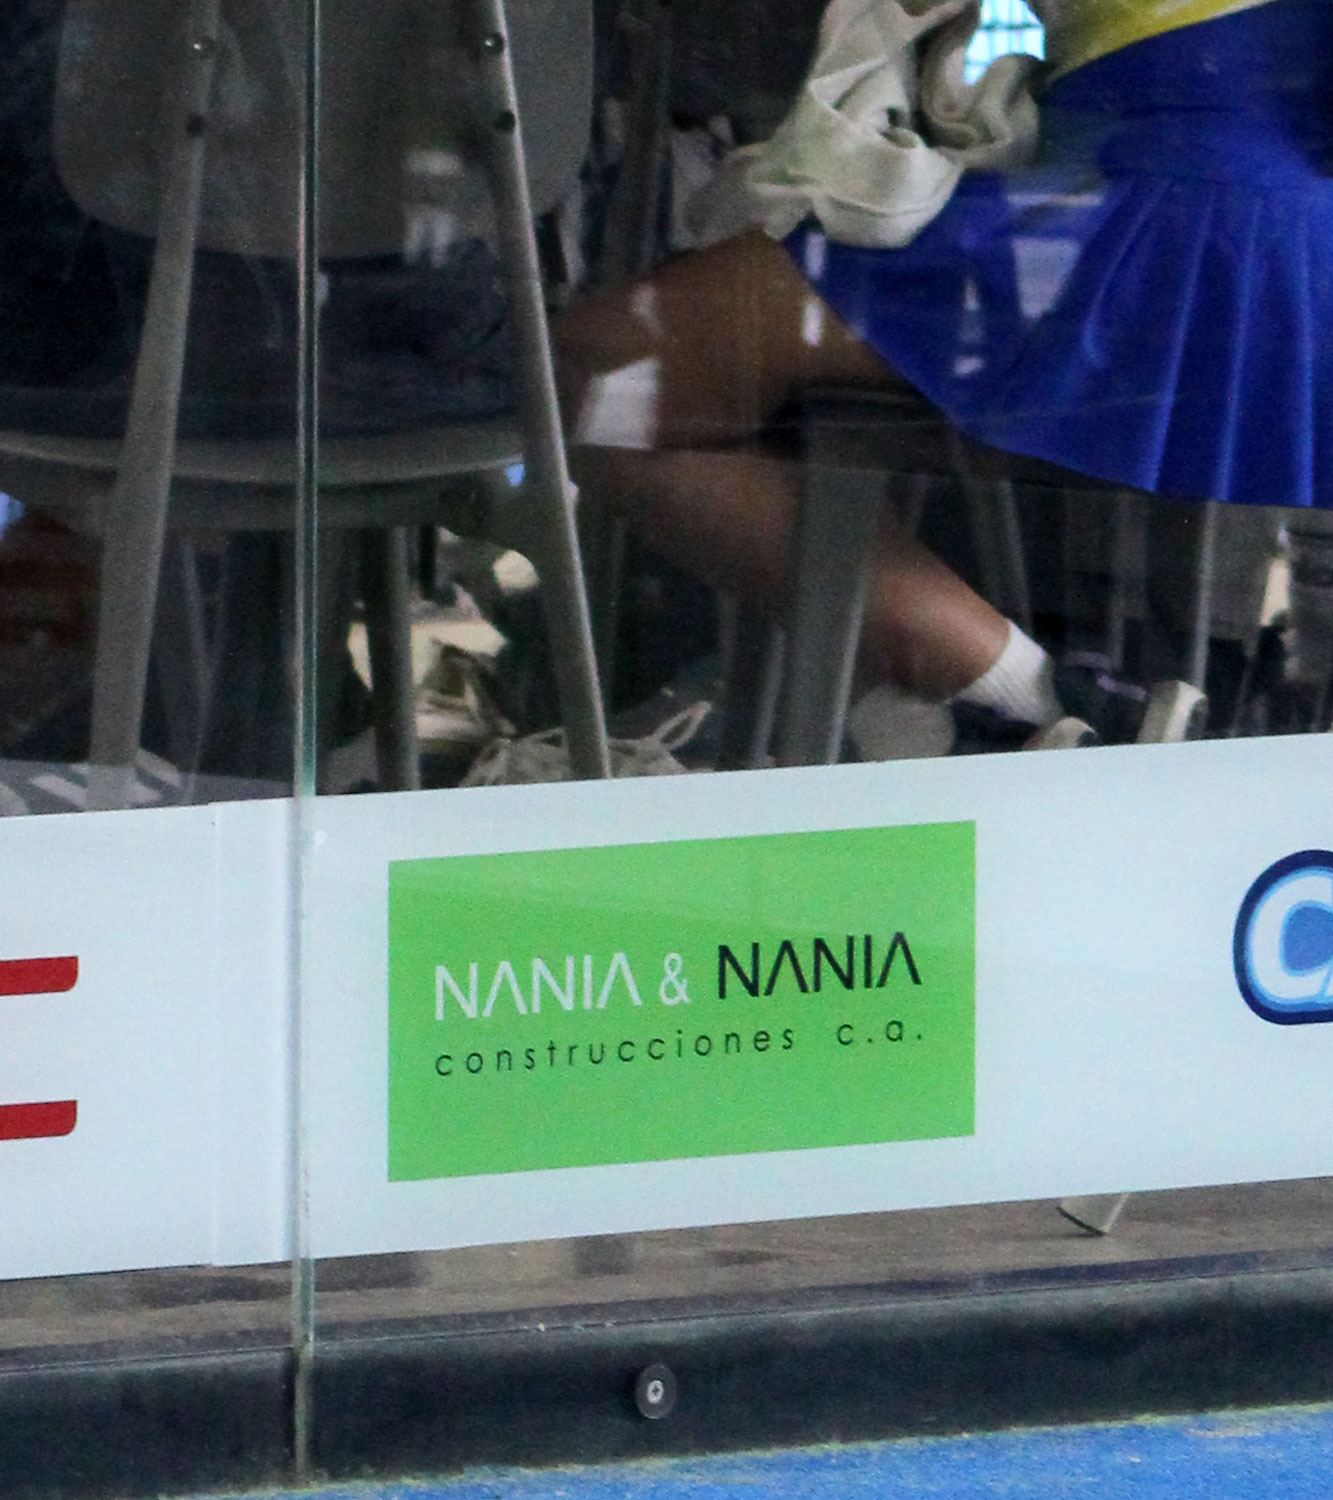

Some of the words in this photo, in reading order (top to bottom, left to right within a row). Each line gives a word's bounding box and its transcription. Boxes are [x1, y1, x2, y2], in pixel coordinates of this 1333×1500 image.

[434, 951, 643, 1021] NANIA
[658, 952, 692, 1007] &
[717, 931, 923, 1000] NANIA
[434, 1029, 796, 1077] construcciones
[836, 1018, 923, 1046] c.a.
